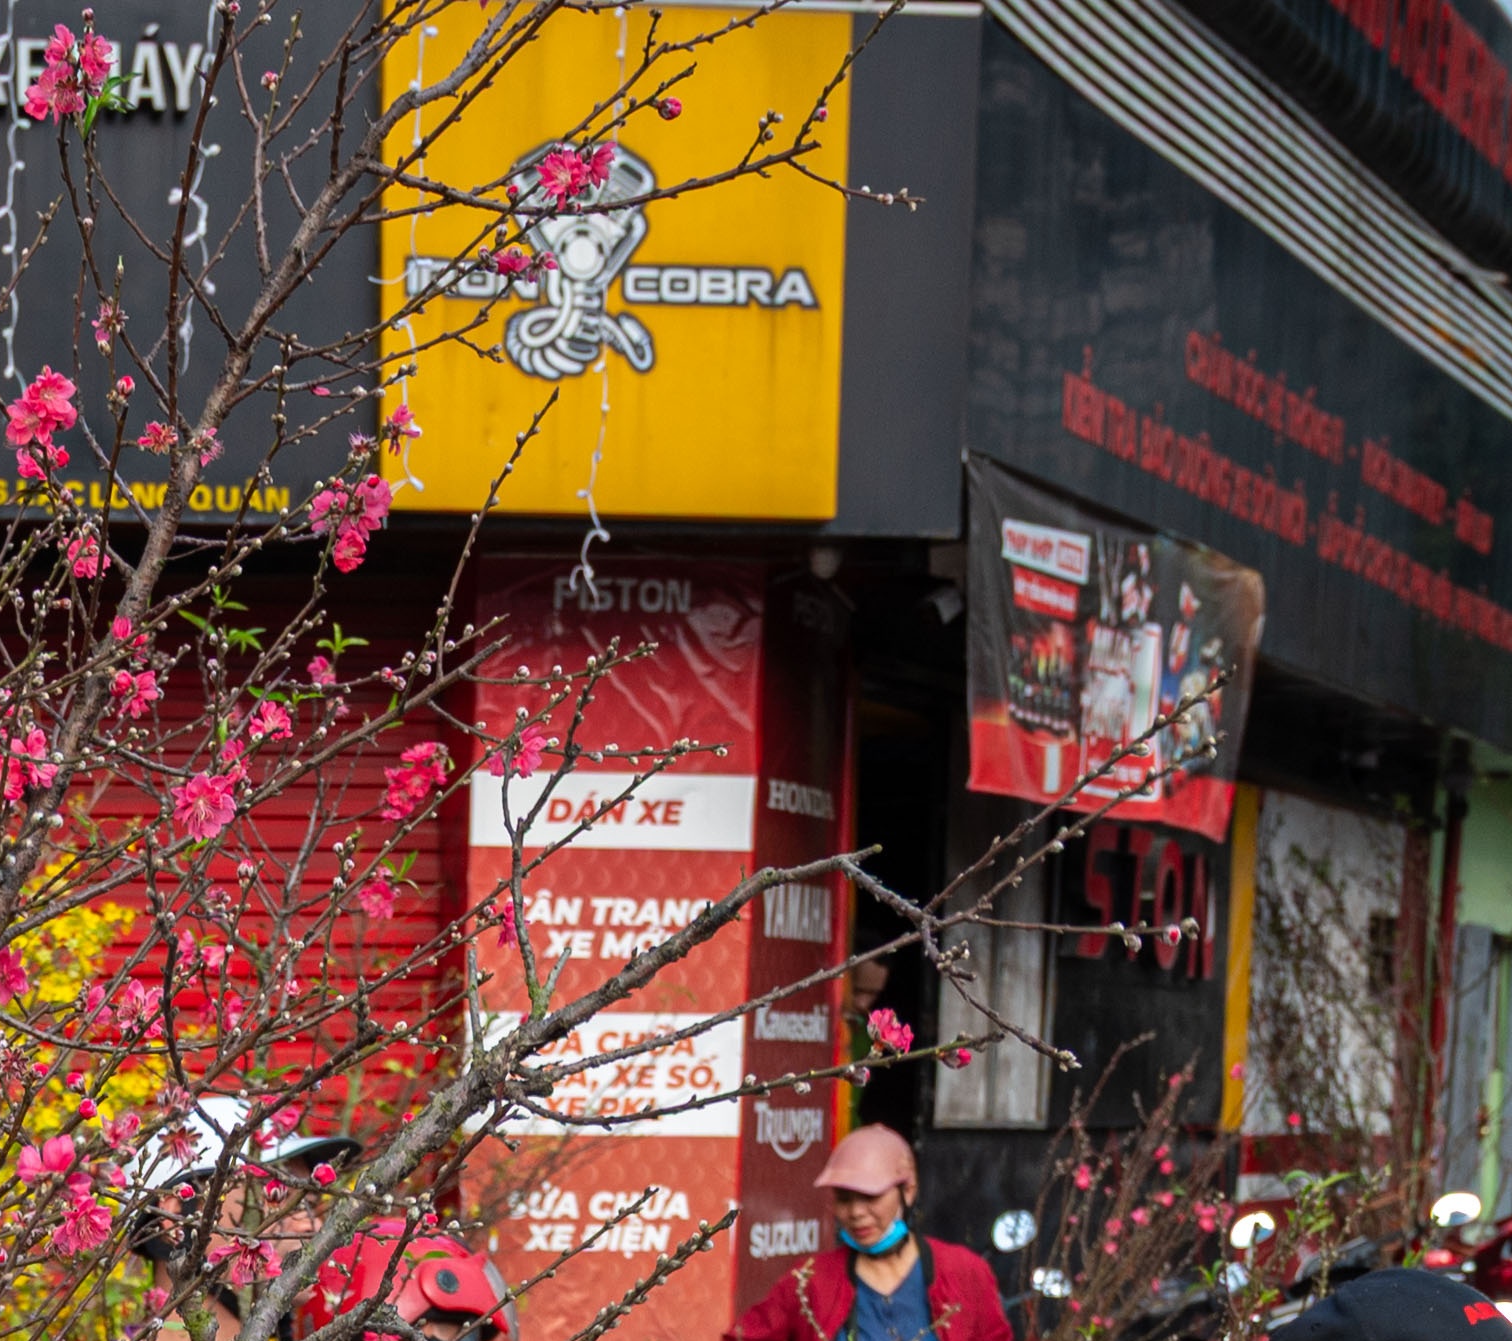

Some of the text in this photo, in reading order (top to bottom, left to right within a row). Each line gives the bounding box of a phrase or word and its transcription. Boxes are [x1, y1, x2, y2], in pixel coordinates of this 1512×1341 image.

[71, 22, 205, 112] ÁY
[623, 265, 817, 306] COBRA
[553, 576, 692, 614] PISTON
[636, 799, 685, 826] XE
[766, 777, 836, 821] HONDA
[544, 929, 595, 961] XE
[753, 1002, 830, 1043] Kawasaki
[612, 1063, 657, 1089] XE
[505, 1179, 691, 1221] SỬA CHỮA
[523, 1223, 575, 1253] XE
[749, 1218, 821, 1260] SUZUKI
